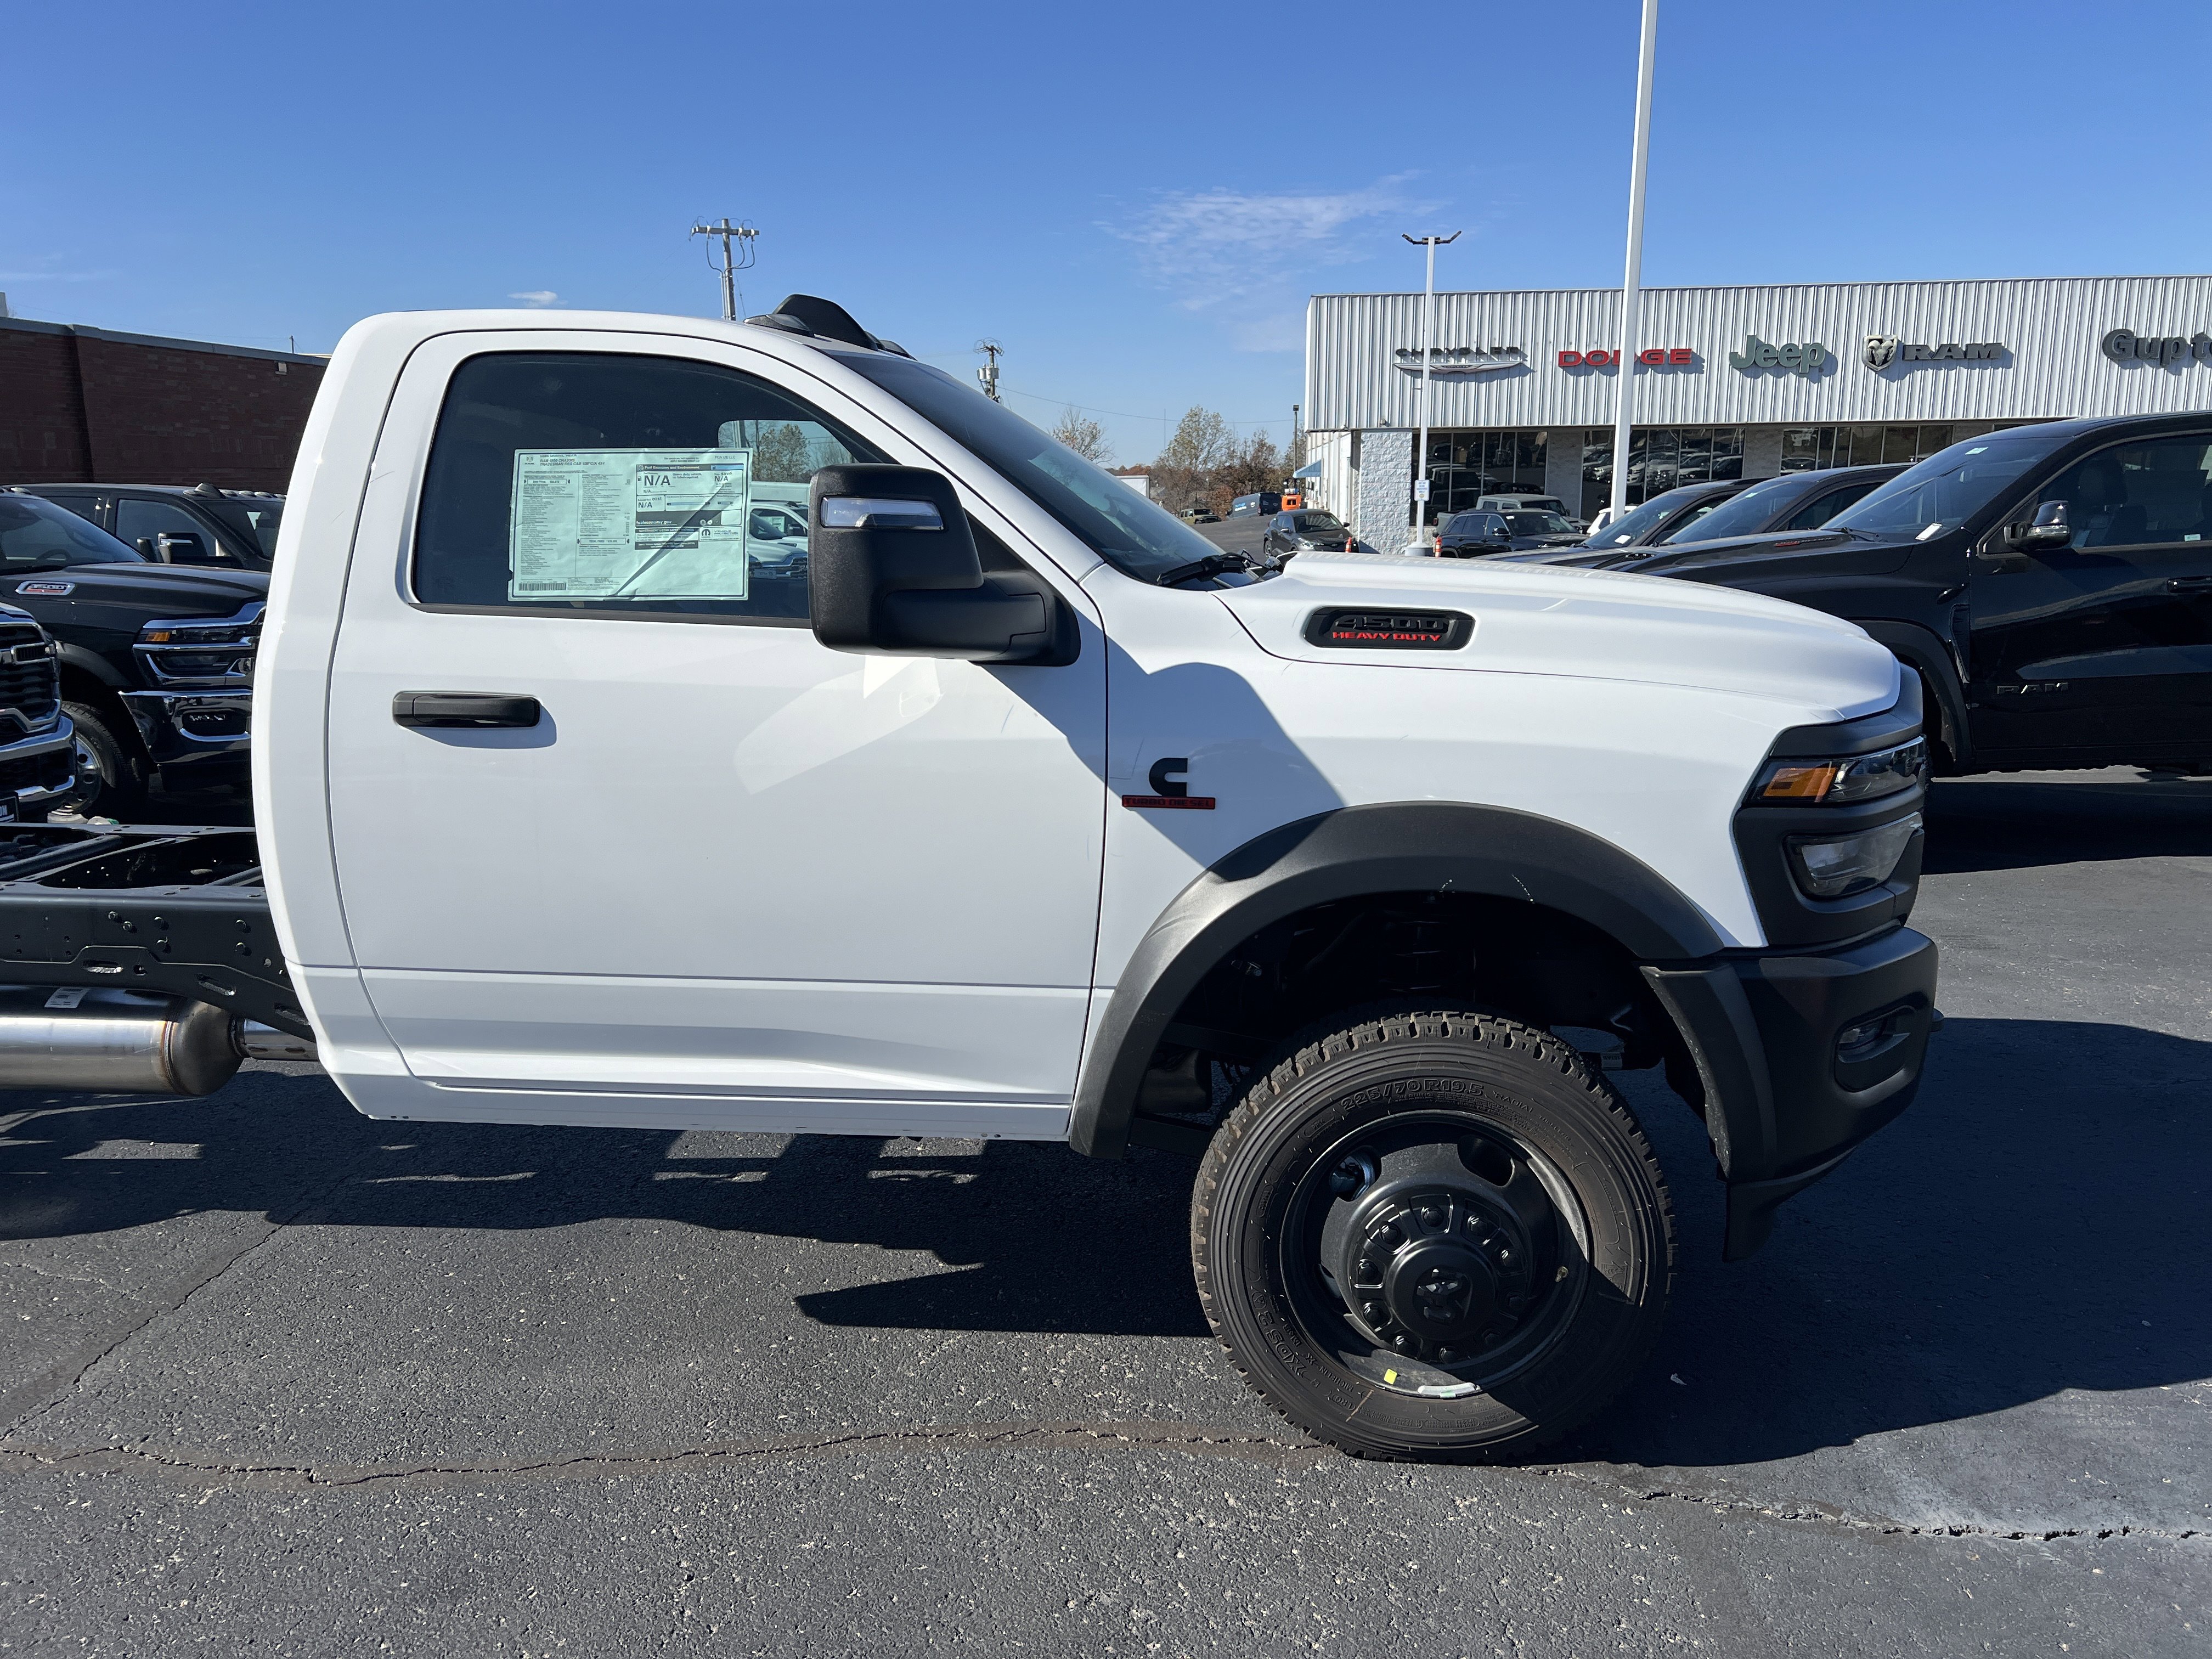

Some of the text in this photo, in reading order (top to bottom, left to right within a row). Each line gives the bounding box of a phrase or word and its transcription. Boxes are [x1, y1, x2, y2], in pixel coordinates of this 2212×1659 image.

[1729, 335, 1826, 374] Jeep
[1903, 342, 2003, 360] RAM
[2102, 329, 2212, 366] Gupt
[644, 475, 670, 486] N/A
[1332, 631, 1442, 642] HEAVY DUTY
[1997, 682, 2069, 695] RAM
[1125, 797, 1211, 807] TURBO DIESEL
[1319, 1365, 1355, 1393] MICHELIN
